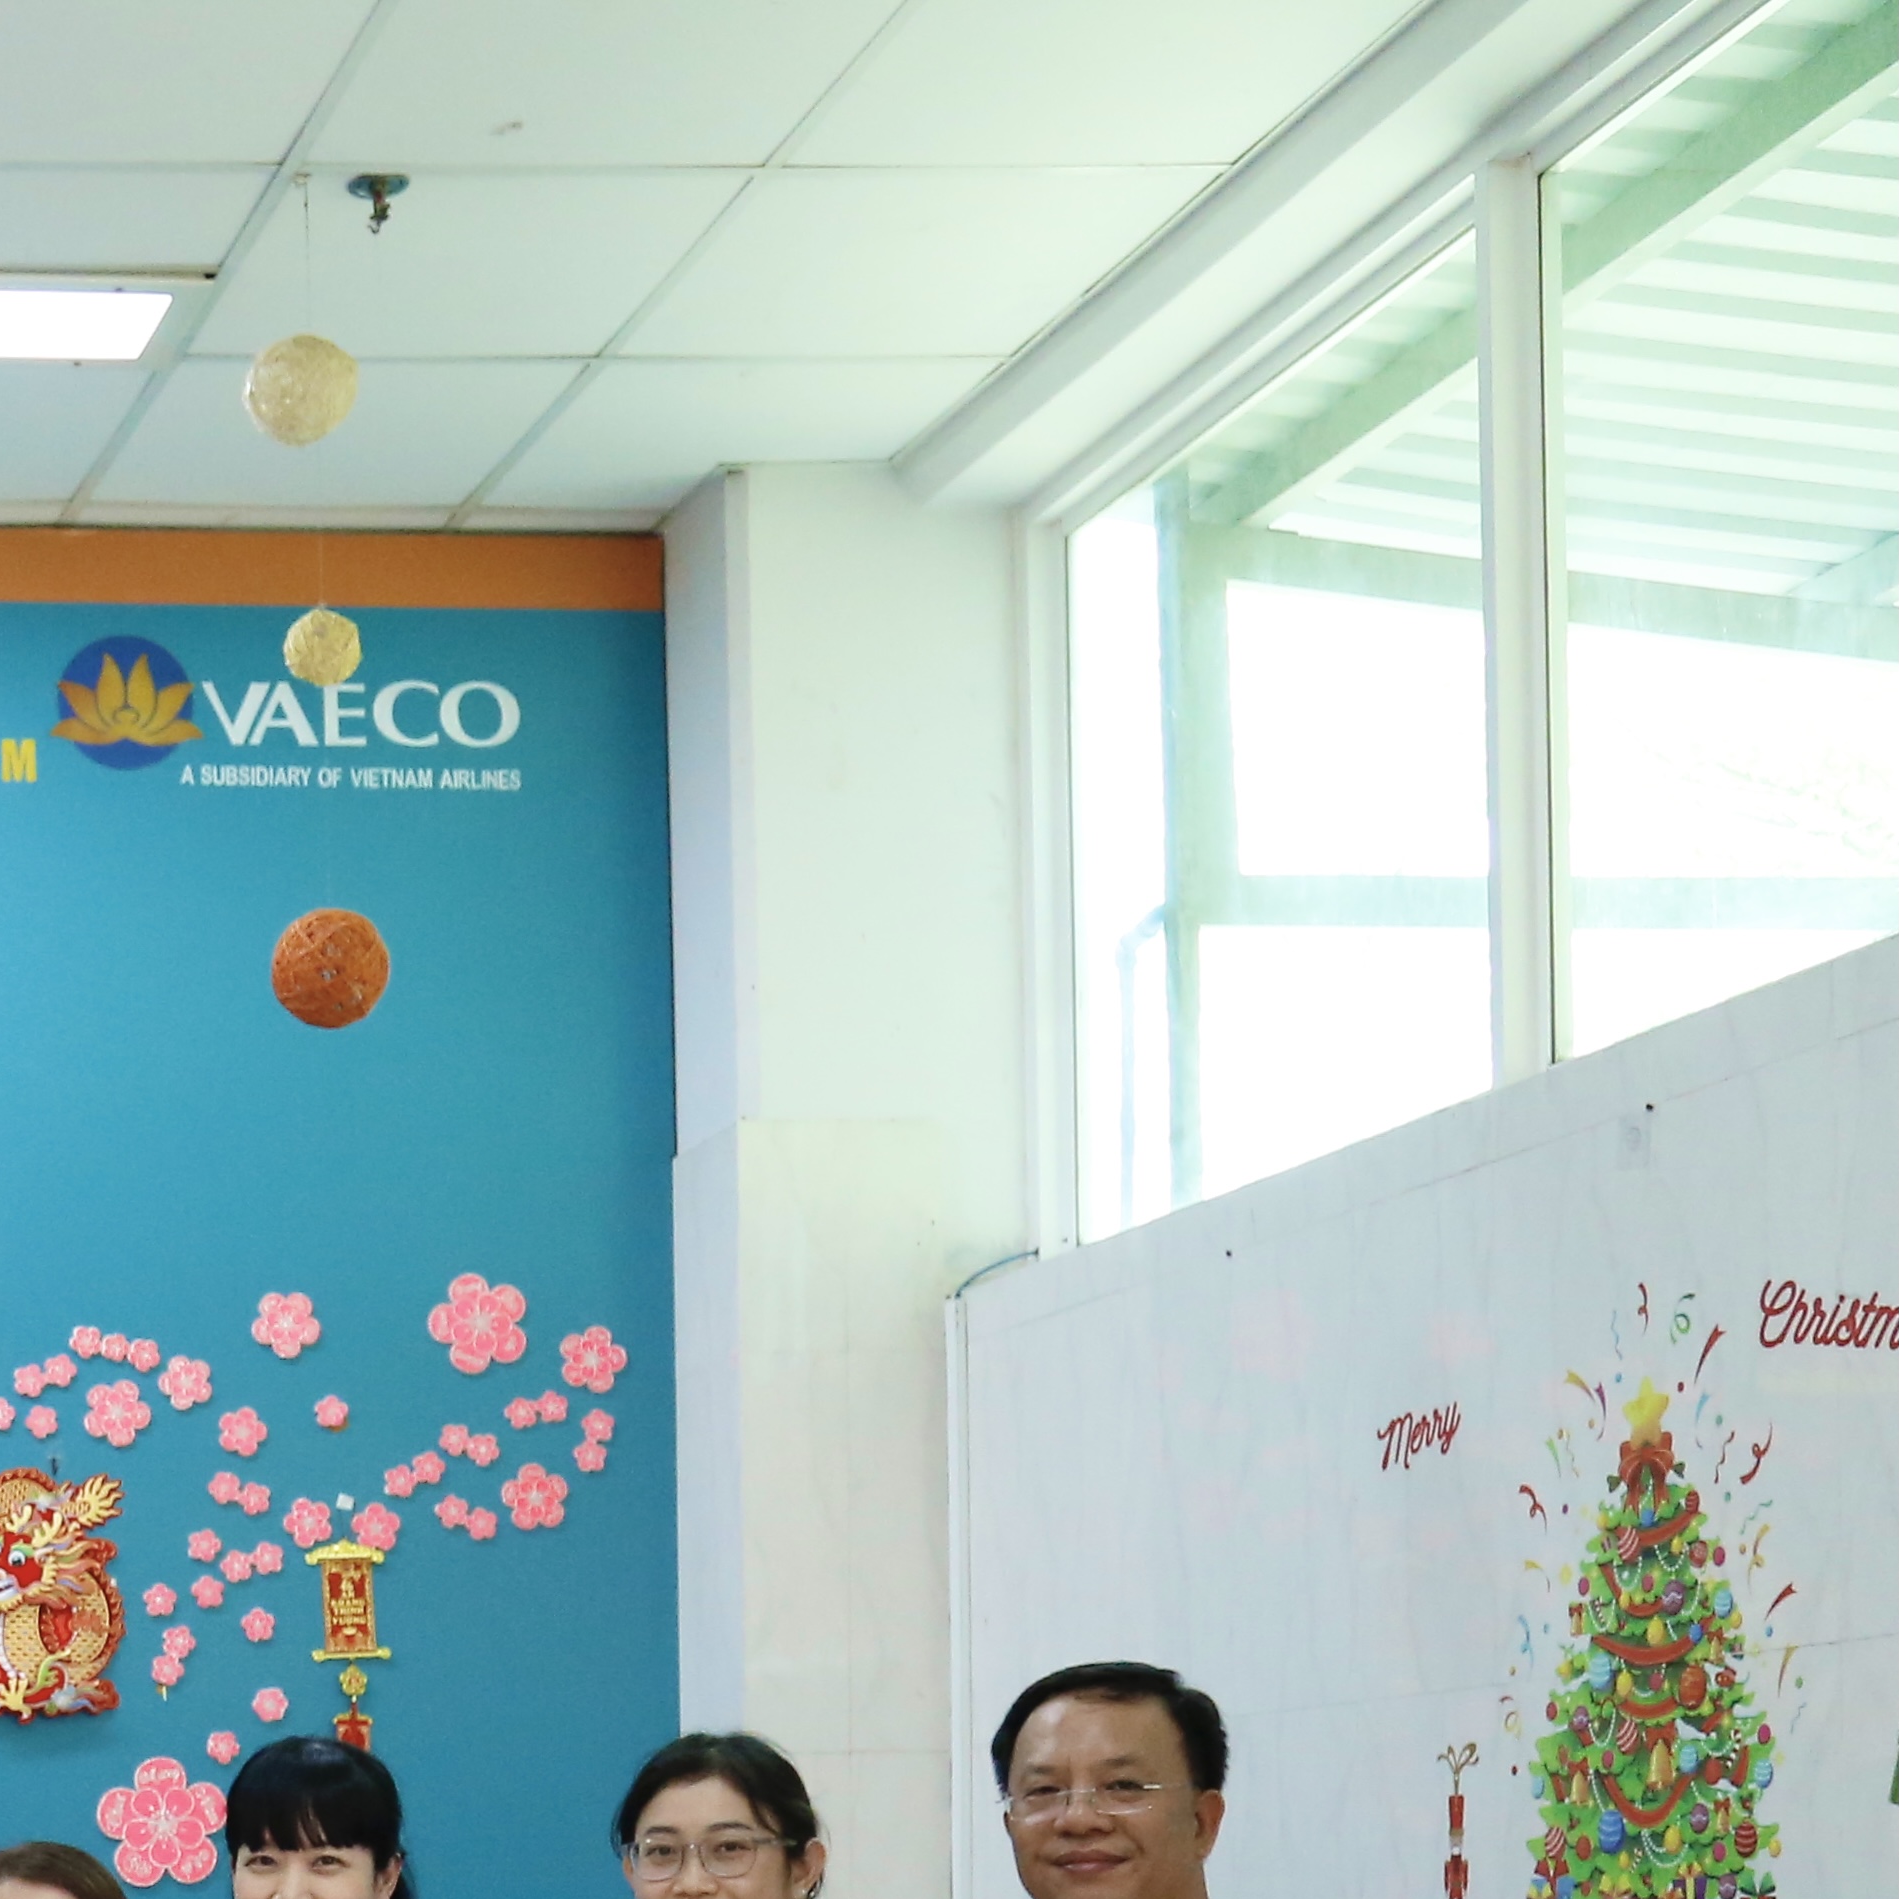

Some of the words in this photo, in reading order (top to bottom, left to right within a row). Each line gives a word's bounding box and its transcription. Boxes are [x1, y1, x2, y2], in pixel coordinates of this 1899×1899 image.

[202, 680, 520, 749] VAECO
[181, 765, 194, 786] A
[201, 764, 312, 788] SUBSIDIARY
[318, 767, 342, 788] OF
[351, 767, 433, 790] VIETNAM
[441, 769, 522, 791] AIRLINES
[1377, 1401, 1461, 1471] Merry
